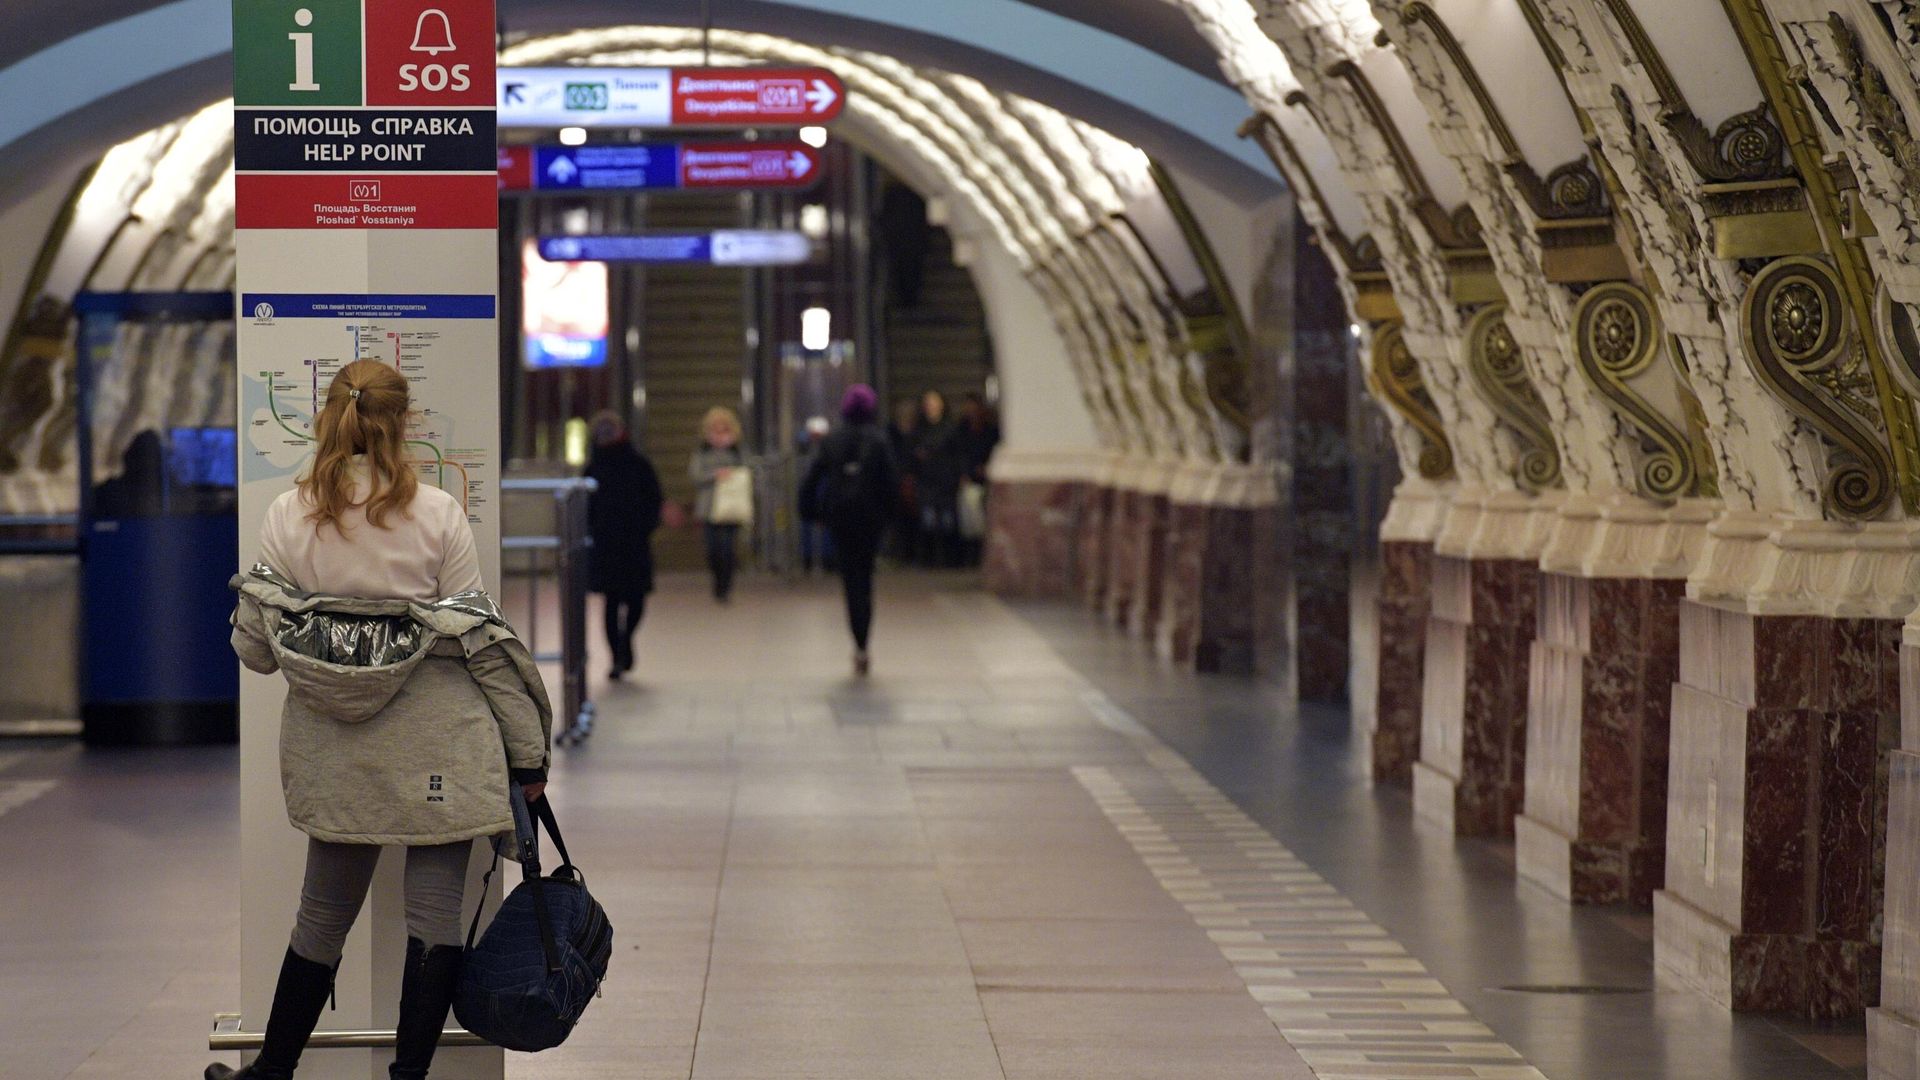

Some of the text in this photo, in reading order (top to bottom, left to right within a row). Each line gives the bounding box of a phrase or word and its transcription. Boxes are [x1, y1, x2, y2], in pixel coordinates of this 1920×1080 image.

[398, 63, 471, 92] SOS
[254, 117, 474, 138] ПОМОЩЬ СПРАВКА
[304, 143, 426, 161] HELP POINT
[313, 203, 417, 214] Площадь Восстания
[361, 215, 415, 226] Vosstaniya
